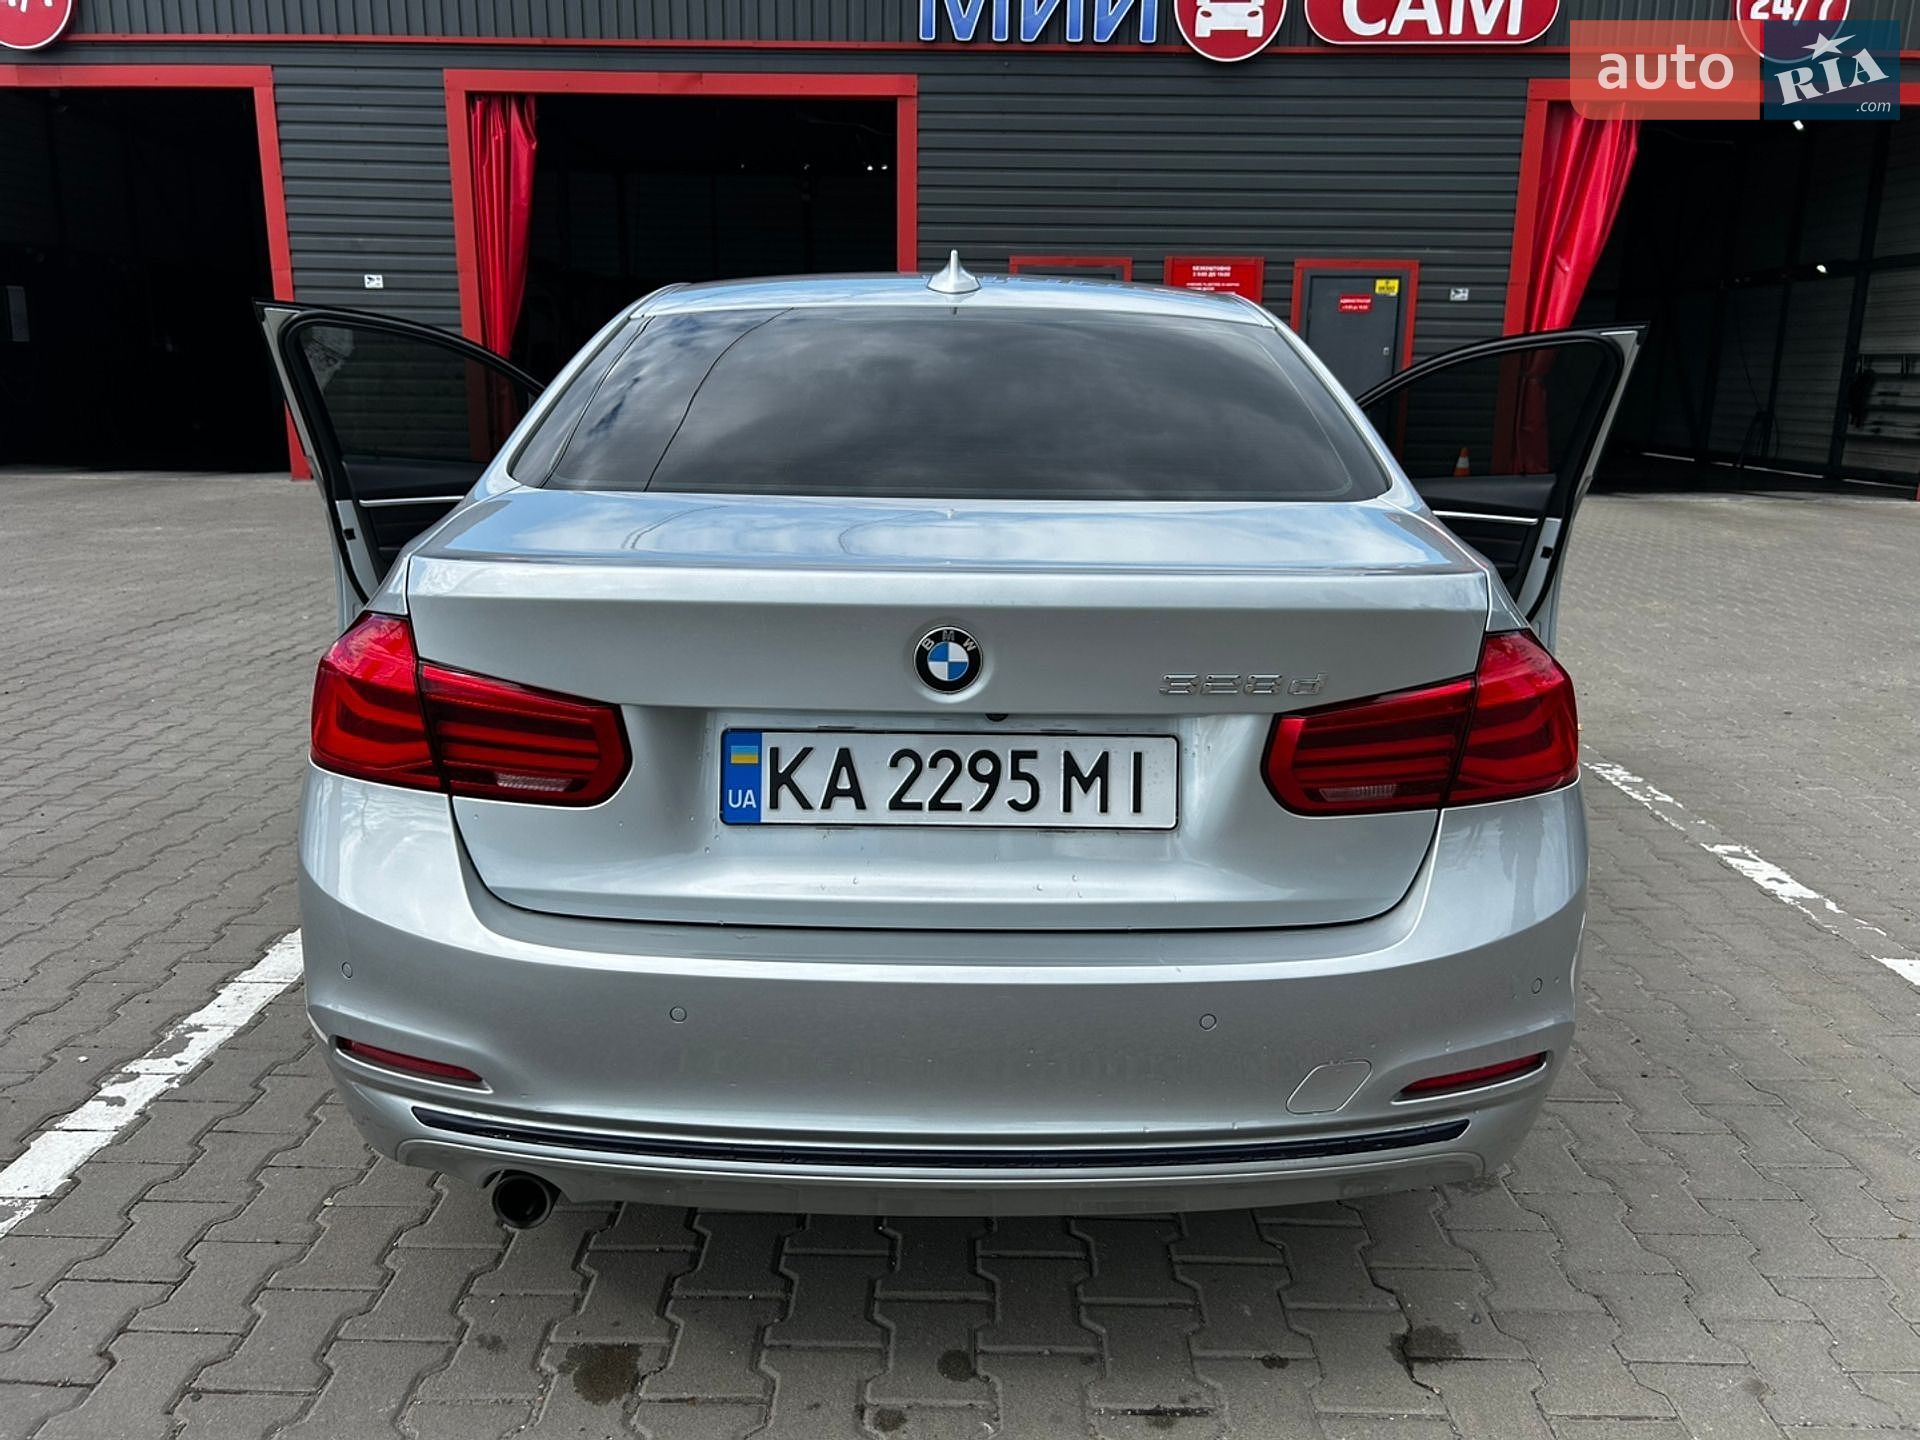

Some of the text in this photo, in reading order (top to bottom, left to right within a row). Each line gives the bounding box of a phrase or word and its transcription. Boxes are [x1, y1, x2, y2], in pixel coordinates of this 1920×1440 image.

[1342, 0, 1523, 36] САМ
[921, 630, 977, 651] BMW
[1158, 673, 1328, 696] 328d
[768, 746, 1143, 813] KA 2295 MI
[727, 788, 758, 809] UA
